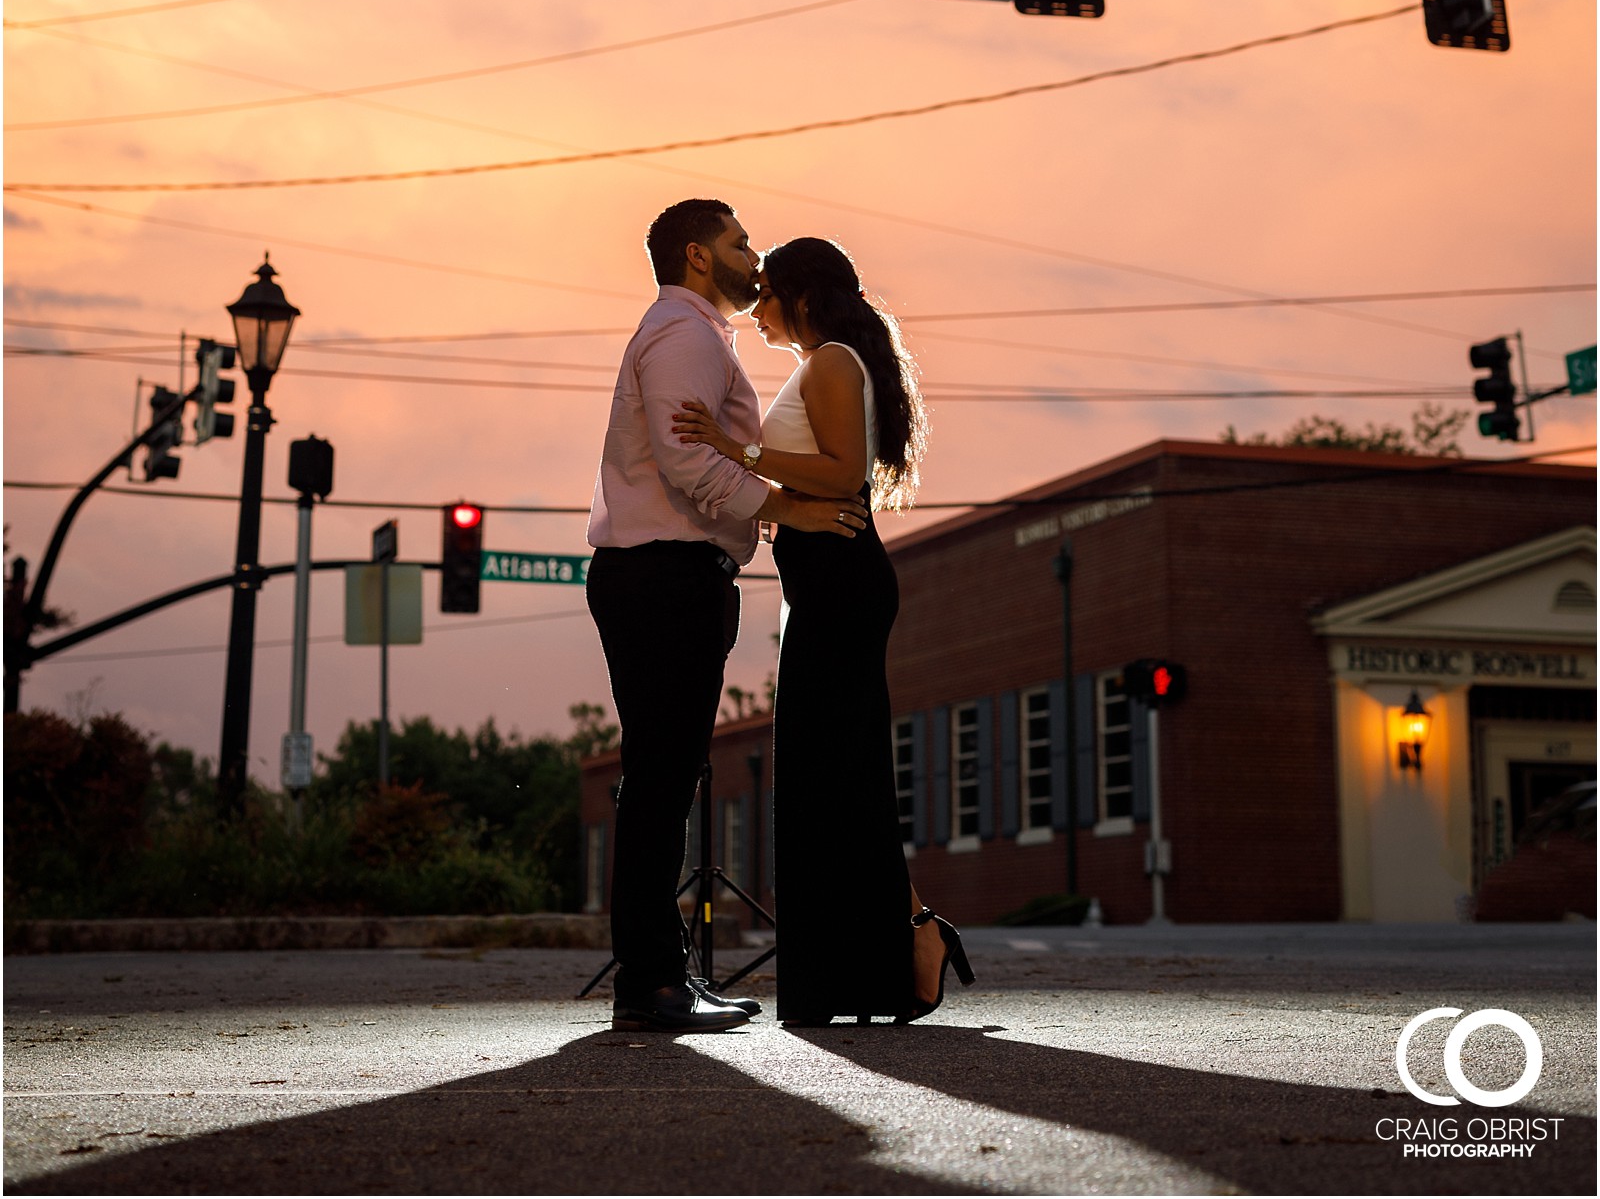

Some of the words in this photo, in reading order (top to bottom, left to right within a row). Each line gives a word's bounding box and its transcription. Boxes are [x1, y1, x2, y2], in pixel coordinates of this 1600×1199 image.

[483, 555, 573, 581] Atlanta
[581, 559, 592, 581] S
[1346, 646, 1464, 675] HISTORIC
[1472, 650, 1587, 680] ROSWELL
